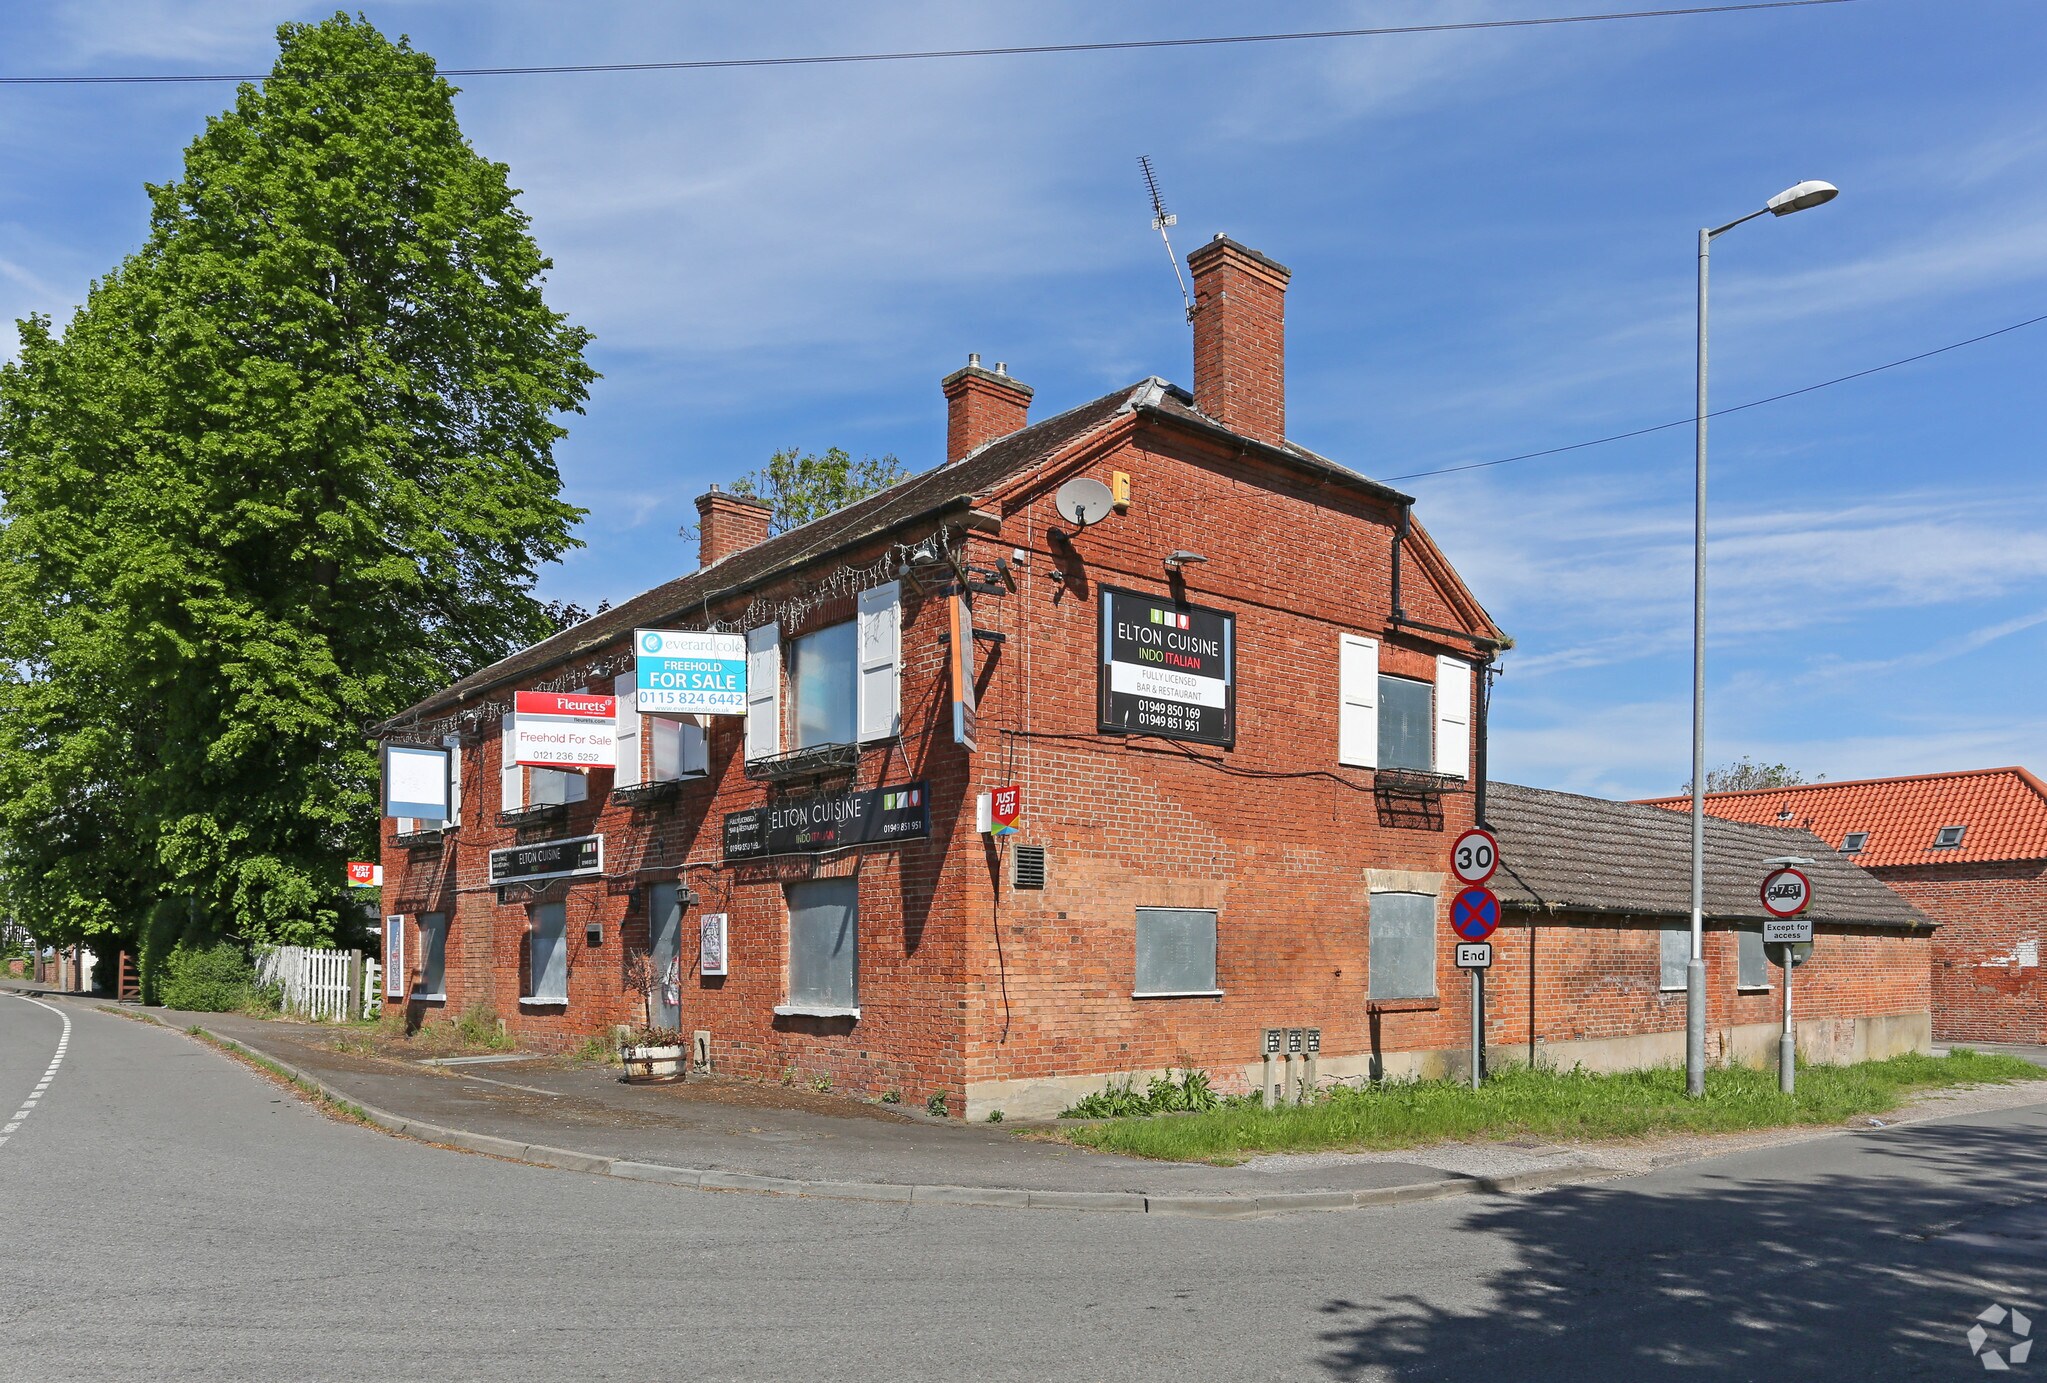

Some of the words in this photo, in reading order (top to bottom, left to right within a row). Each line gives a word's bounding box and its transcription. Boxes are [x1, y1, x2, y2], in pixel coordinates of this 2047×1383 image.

[665, 638, 713, 651] everard
[716, 639, 743, 653] cole
[1118, 622, 1162, 646] ELTON
[1167, 633, 1219, 657] CUISINE
[1139, 647, 1164, 662] INDO
[1165, 652, 1200, 669] ITALIAN
[664, 660, 722, 672] FREEHOLD
[650, 672, 687, 688] FOR
[691, 674, 736, 690] SALE
[1142, 670, 1163, 682] FULLY
[1164, 673, 1197, 687] LICENSED
[1136, 682, 1151, 693] BAR
[1151, 685, 1157, 694] &
[1158, 686, 1202, 700] RESTAURANT
[557, 698, 606, 711] Fleurets
[640, 692, 674, 704] 0115
[678, 693, 705, 704] 824
[708, 694, 743, 706] 6442
[655, 705, 730, 713] www.everardcole.co.uk
[1138, 699, 1166, 715] 01949
[1167, 704, 1183, 717] 850
[1185, 707, 1200, 719] 169
[1139, 712, 1166, 727] 01949
[1167, 716, 1183, 730] 851
[1185, 719, 1200, 732] 951
[520, 732, 566, 744] Freehold
[569, 734, 585, 745] For
[589, 735, 612, 745] Sale
[533, 751, 553, 760] 0121
[556, 752, 574, 761] 236
[577, 753, 599, 762] 5252
[996, 790, 1016, 806] JUST
[772, 807, 808, 829] ELTON
[812, 799, 861, 823] CUISINE
[1000, 803, 1016, 816] EAT
[883, 824, 900, 833] 01949
[900, 822, 911, 831] 851
[911, 820, 922, 830] 951
[796, 832, 811, 844] INDO
[519, 850, 537, 864] ELTON
[538, 847, 561, 861] CUISINE
[1457, 845, 1492, 870] 30
[1778, 884, 1800, 895] 7.5T
[1767, 924, 1795, 932] Except
[1462, 950, 1485, 961] End
